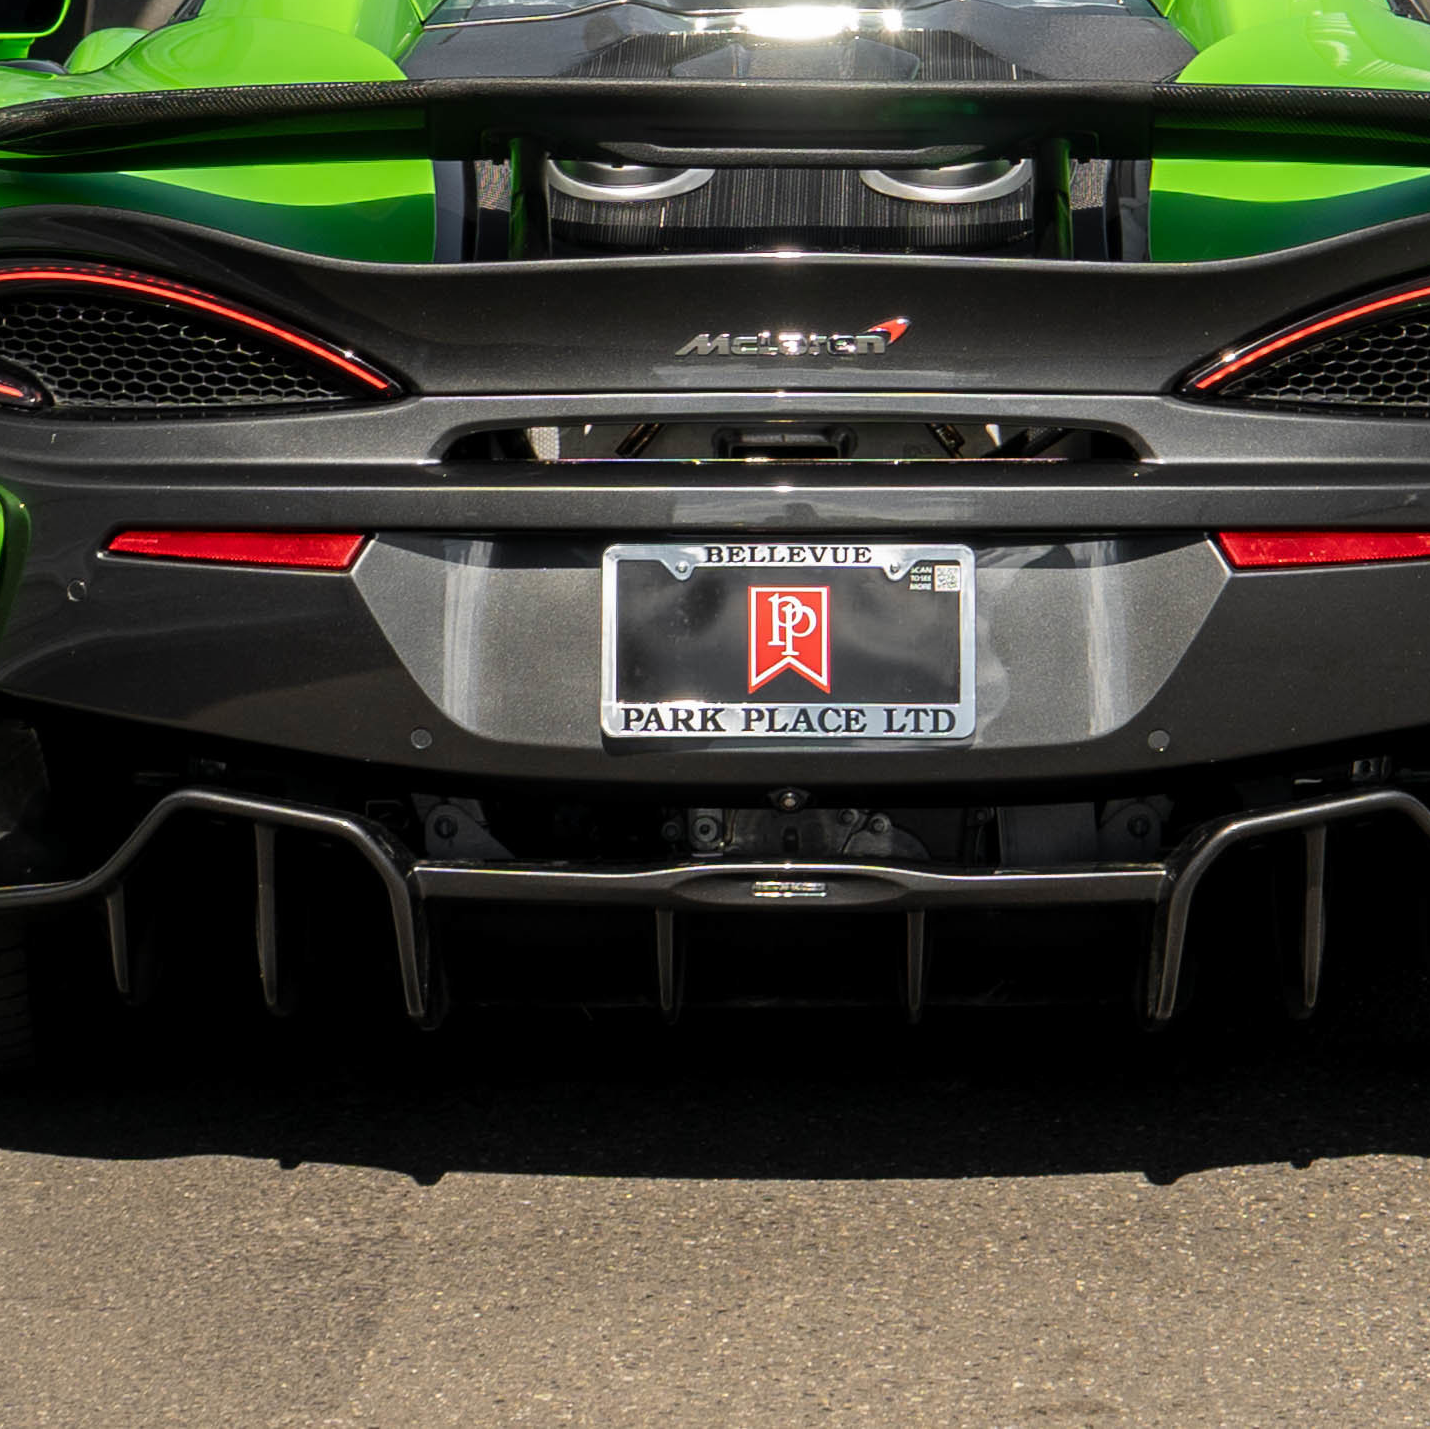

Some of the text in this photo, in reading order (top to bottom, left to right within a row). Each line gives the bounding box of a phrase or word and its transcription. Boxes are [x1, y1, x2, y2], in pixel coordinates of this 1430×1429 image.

[704, 545, 872, 564] BELLEVUE
[621, 707, 957, 734] PARK PLACE LTD
